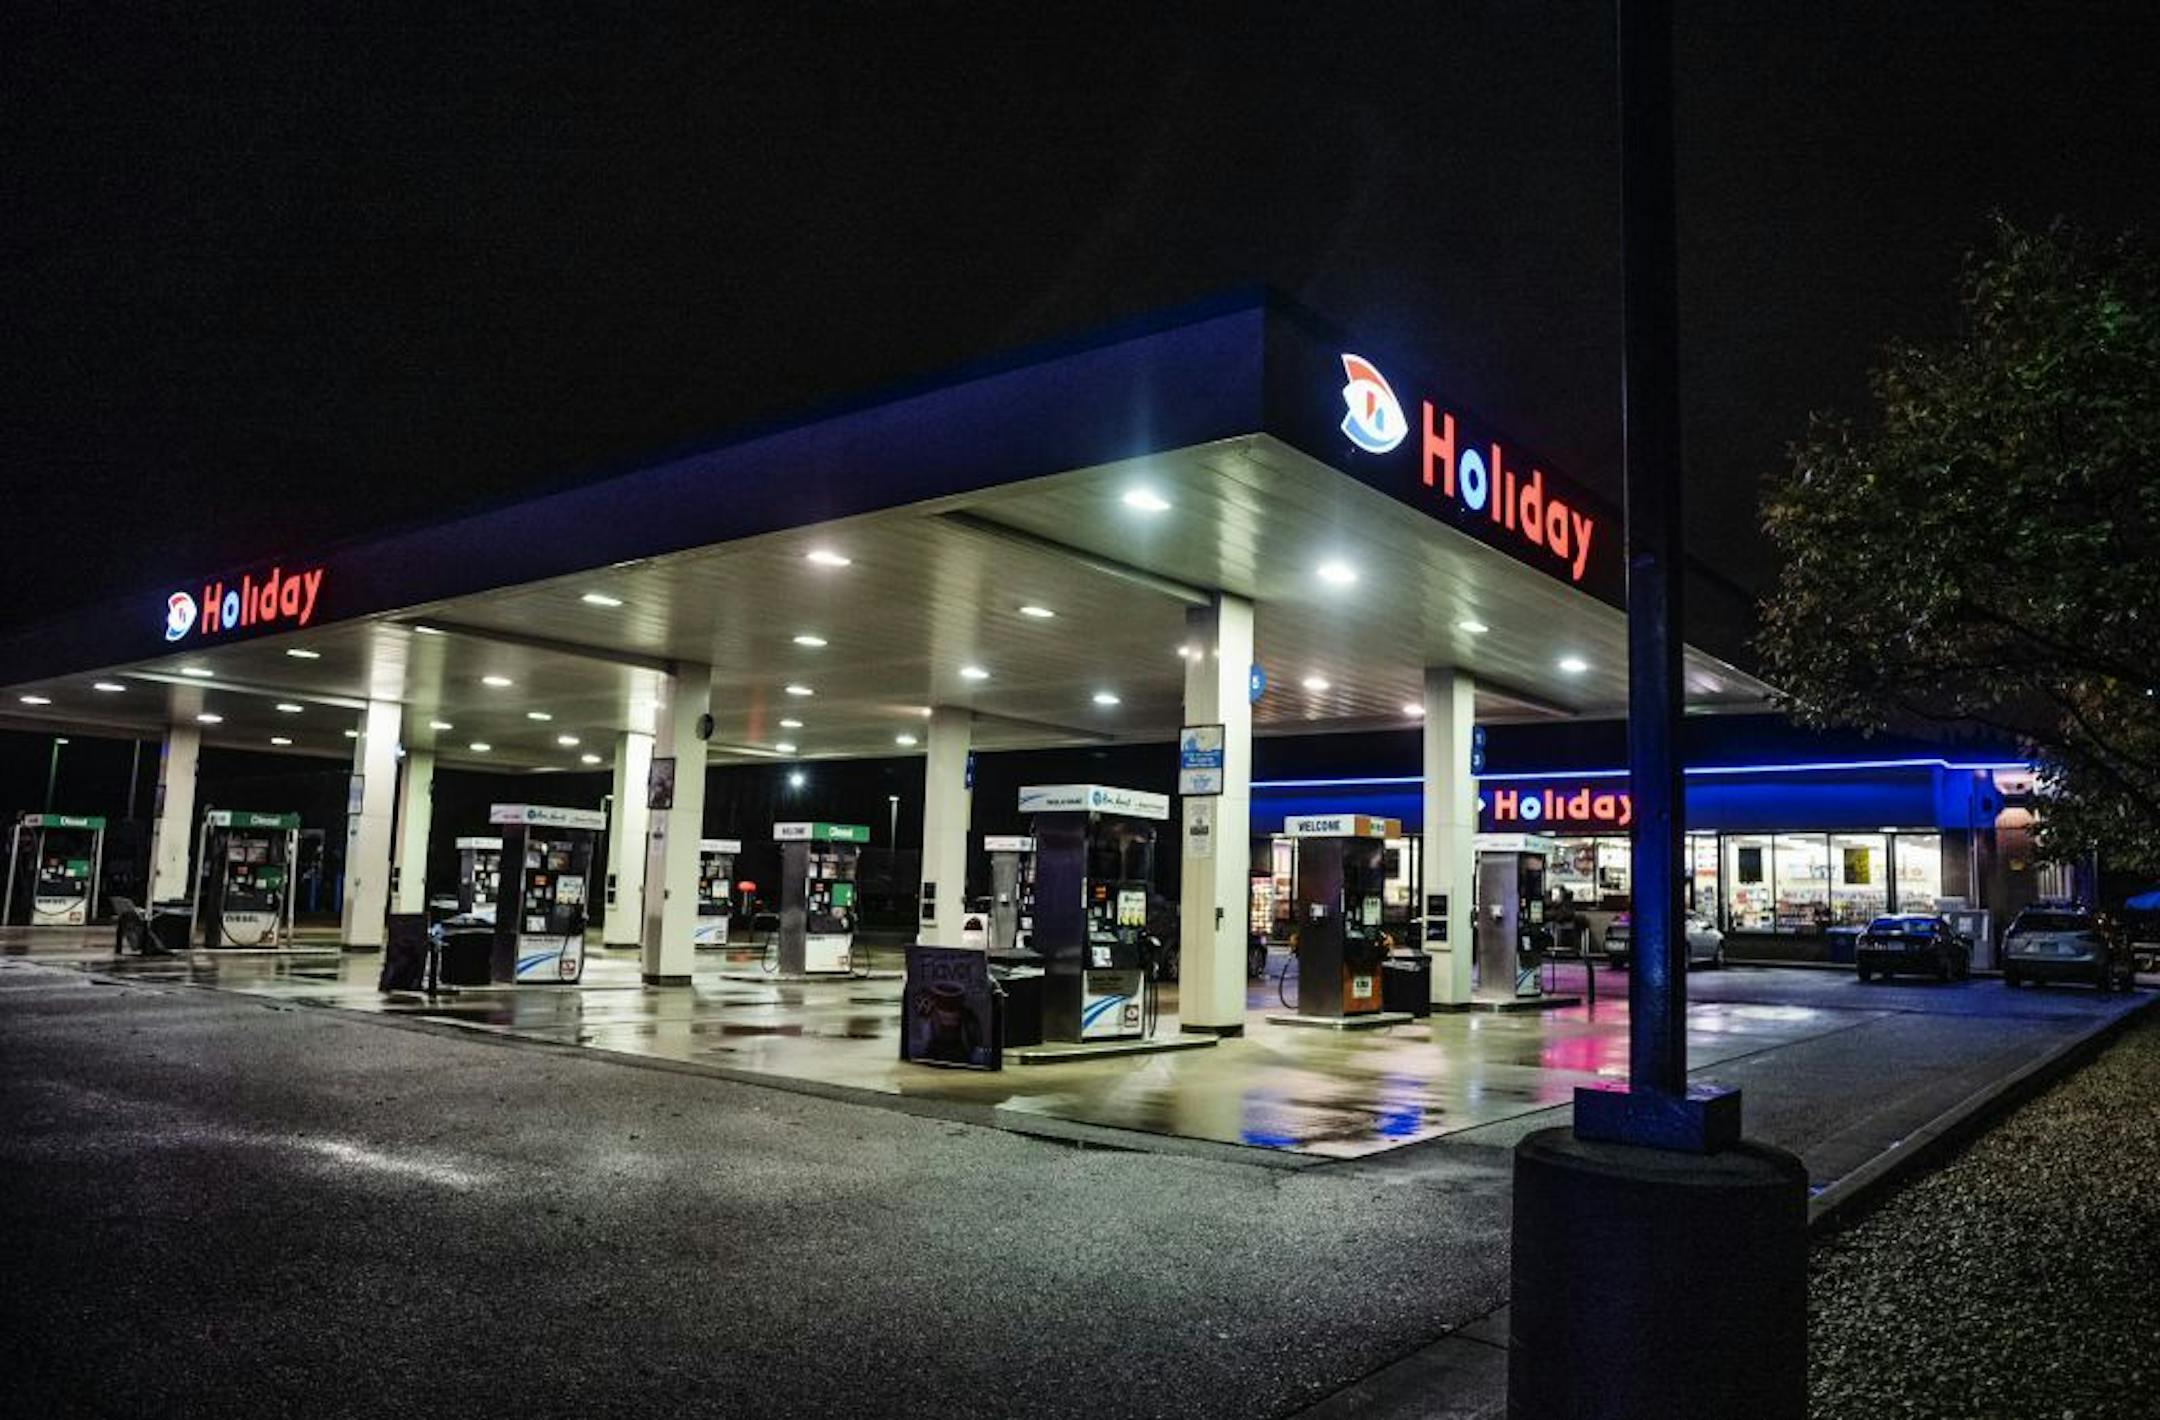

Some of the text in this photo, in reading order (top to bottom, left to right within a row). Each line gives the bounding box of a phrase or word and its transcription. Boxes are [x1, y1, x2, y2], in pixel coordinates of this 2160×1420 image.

[1422, 399, 1594, 582] Holiday
[201, 567, 323, 635] Holiday
[1299, 819, 1341, 832] WELCOME
[1494, 788, 1632, 826] Holiday
